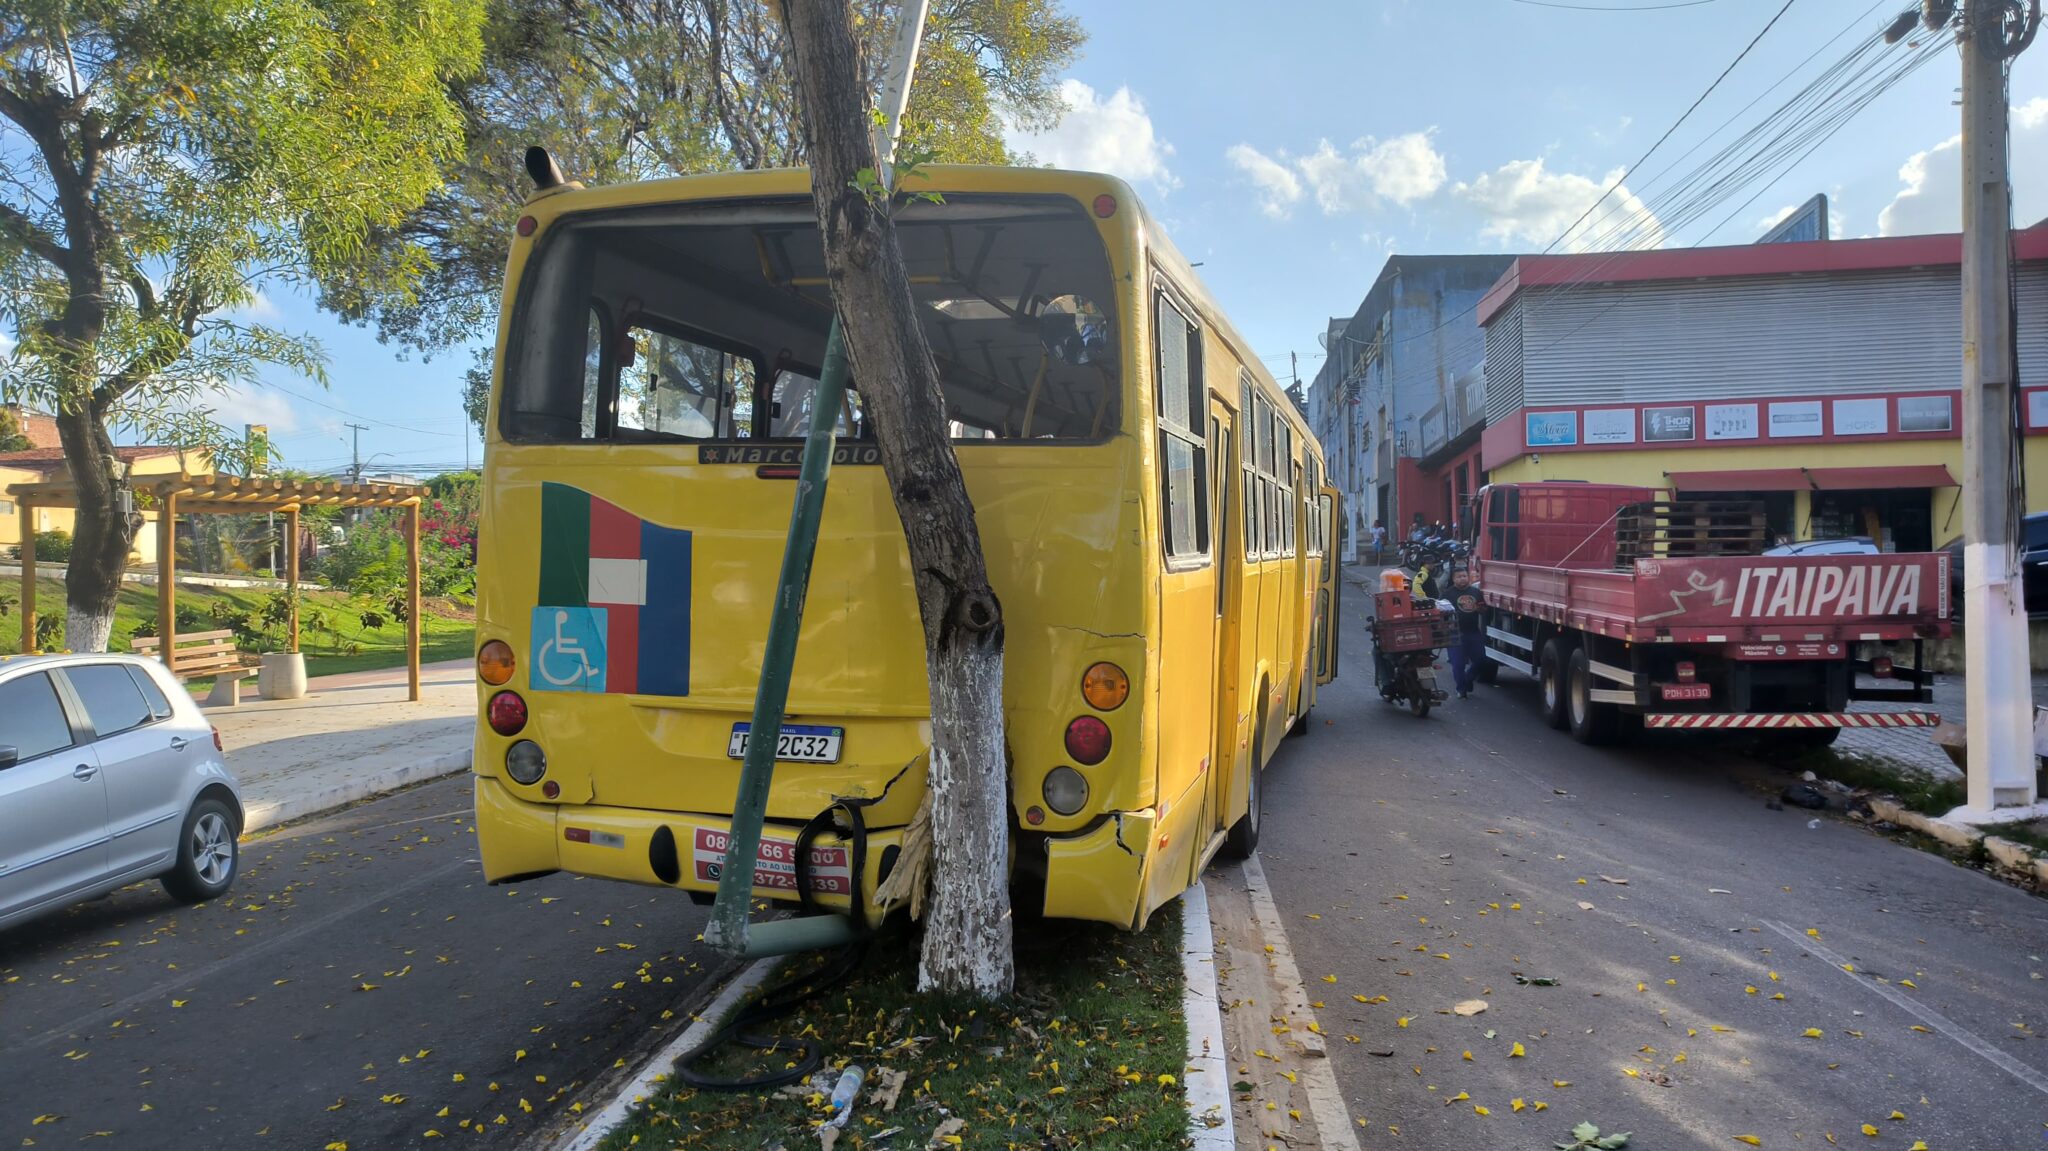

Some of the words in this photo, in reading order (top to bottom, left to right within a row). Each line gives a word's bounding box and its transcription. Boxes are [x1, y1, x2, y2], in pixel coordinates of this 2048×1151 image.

[1664, 416, 1691, 425] THOR
[725, 447, 879, 464] Marcolo
[1731, 565, 1921, 618] ITAIPAVA
